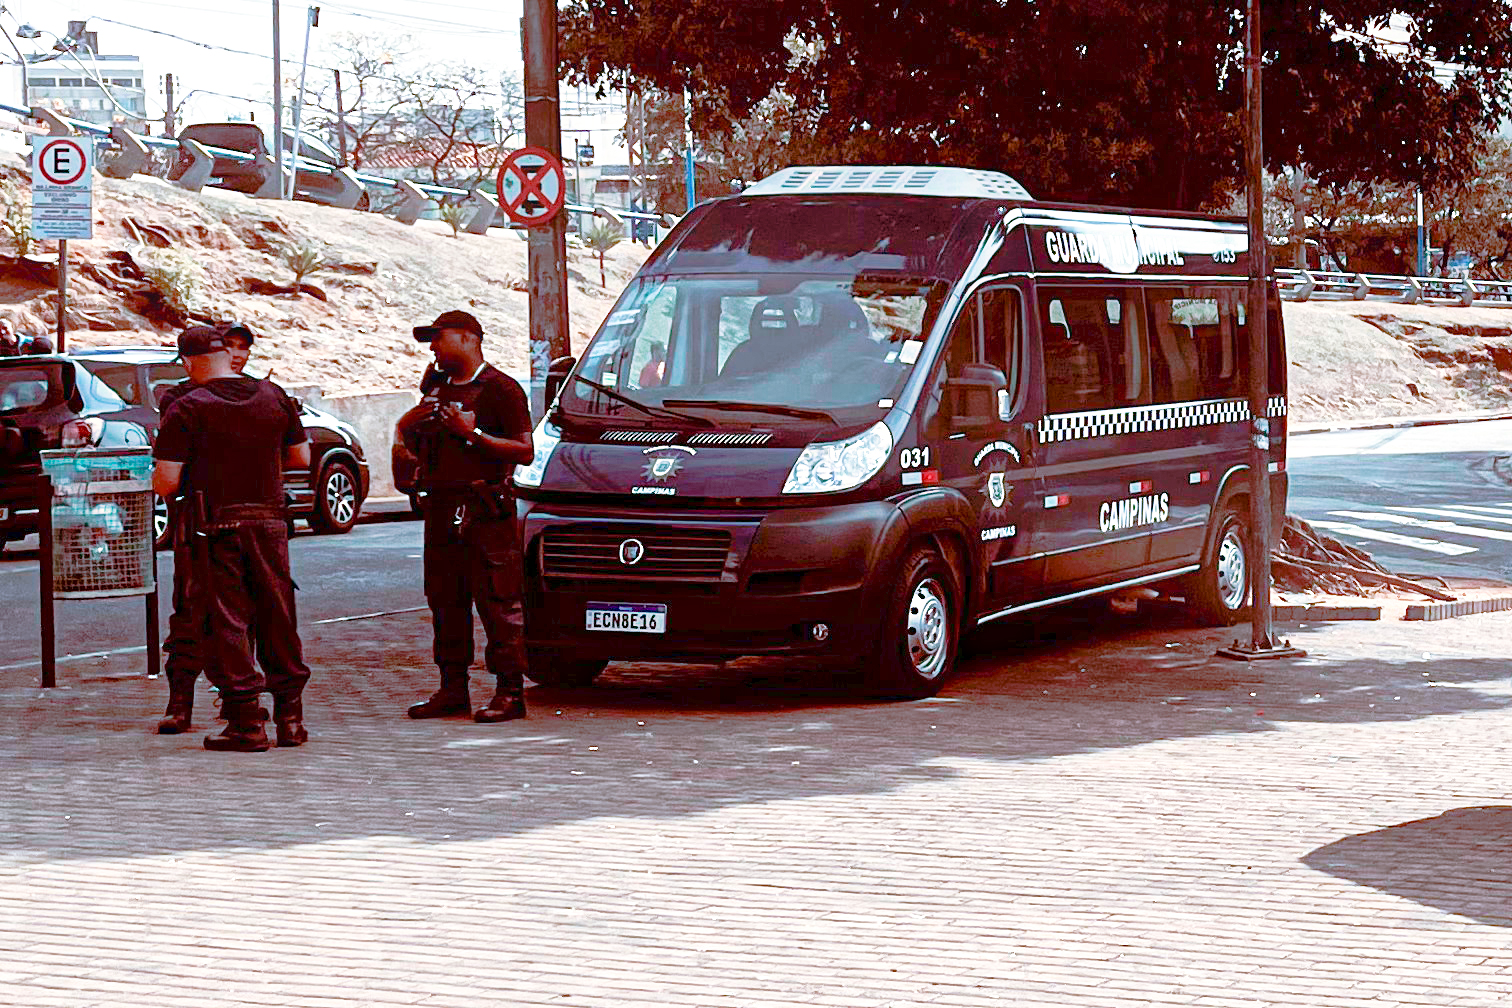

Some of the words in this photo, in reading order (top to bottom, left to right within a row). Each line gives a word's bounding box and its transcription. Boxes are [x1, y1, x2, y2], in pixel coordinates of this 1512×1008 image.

[54, 148, 69, 173] E
[900, 446, 930, 468] 031
[631, 486, 676, 496] CAMPINAS
[1100, 492, 1169, 532] CAMPINAS
[980, 525, 1016, 541] CAMPINAS
[593, 612, 657, 630] ECN8E16
